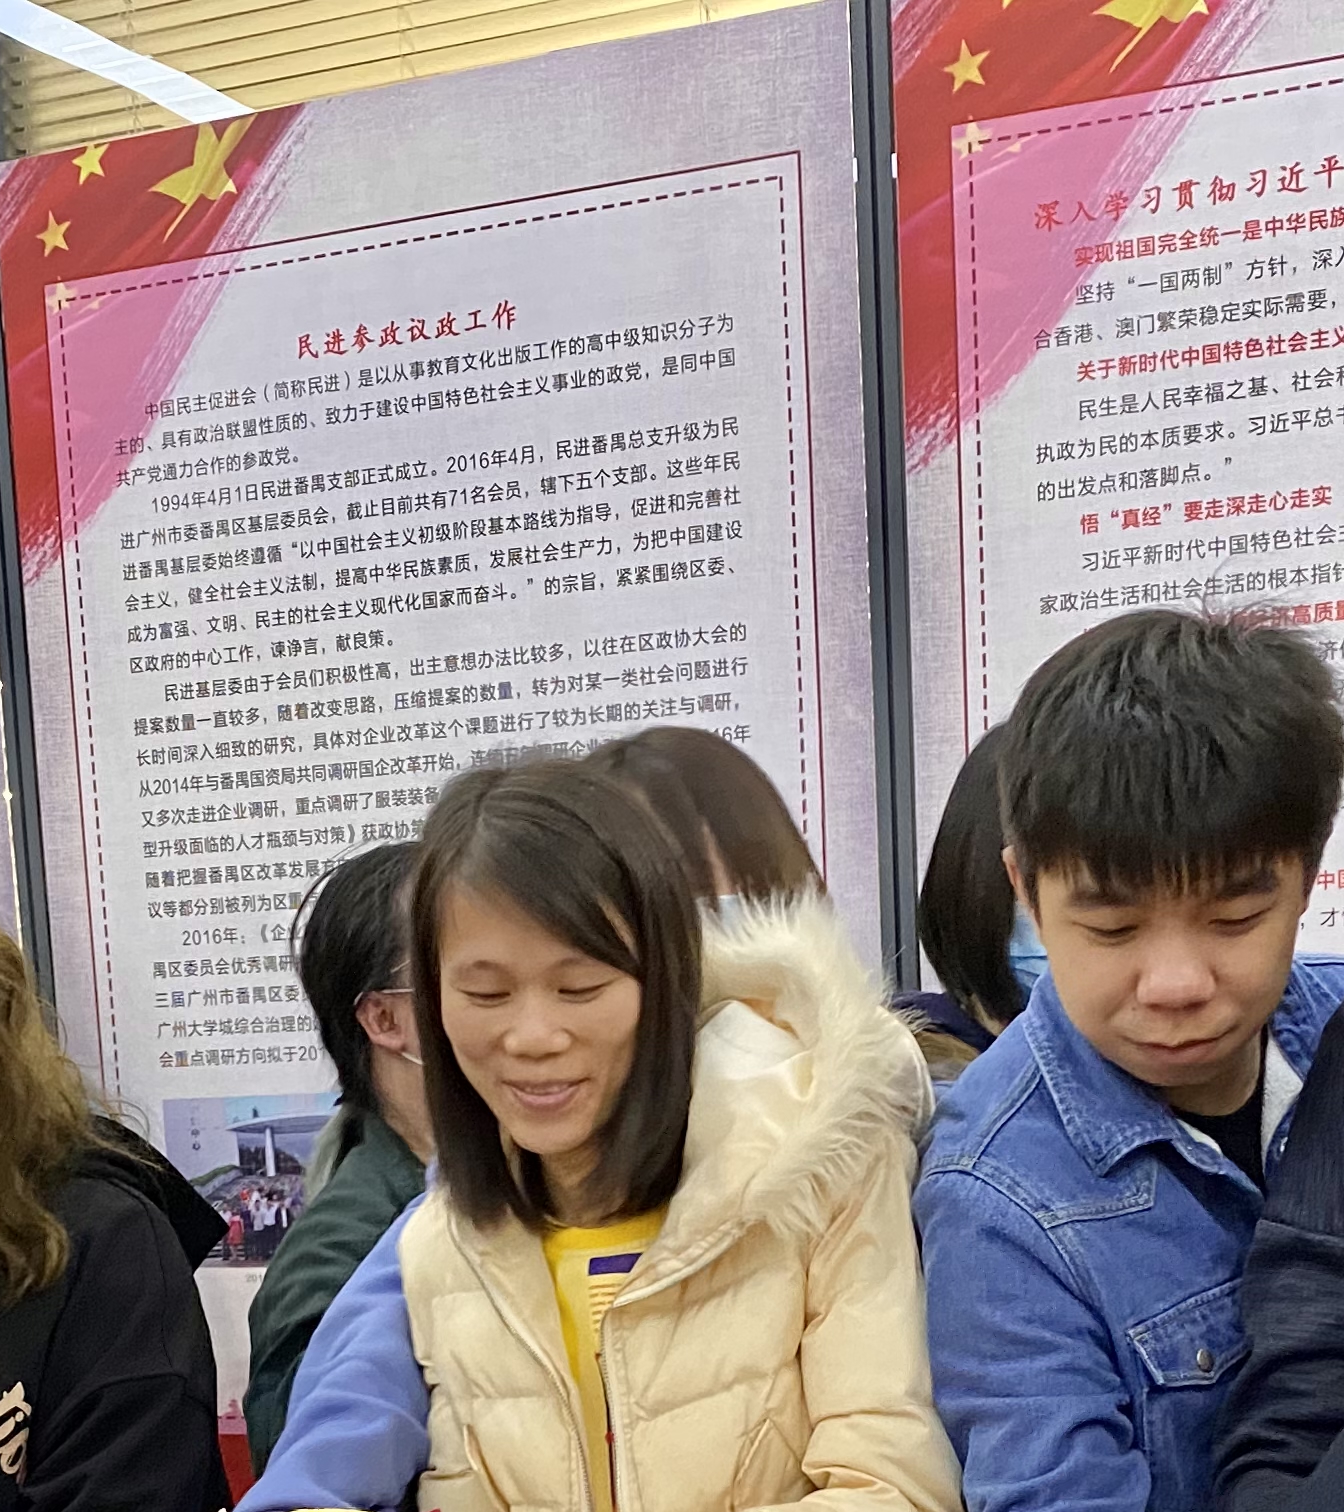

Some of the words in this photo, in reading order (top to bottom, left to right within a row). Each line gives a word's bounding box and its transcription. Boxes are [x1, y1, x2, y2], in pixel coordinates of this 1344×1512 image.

[143, 311, 734, 422] 中国民主促进会（简称民进）是以从事教育文化出版工作的高中级知识分子为
[295, 299, 518, 363] 民进参政议政工作
[113, 346, 736, 458] 主的、具有政治联盟性质的、致力于建设中国特色社会主义事业的政党，是同中国
[115, 443, 301, 489] 共产党通力合作的参政党。
[119, 450, 740, 551] 进广州市委番禺区基层委员会，截止目前共有71名会员，辖下五个支部。这些年民
[151, 415, 739, 515] 1994年4月1日民进番禺支部正式成立。2016年4月，民进番禺总支升级为民
[123, 520, 743, 613] 会主义，健全社会主义法制，提高中华民族素质，发展社会生产力，为把中国建设
[129, 627, 397, 675] 区政府的中心工作，谏诤言，献良策。
[163, 623, 748, 701] 民进基层委由于会员们积极性高，出主意想办法比较多，以往在区政协大会的
[136, 693, 740, 766] 长时间深入细致的研究，具体对企业改革这个课题进行了较为长期的关注与调研，
[154, 984, 306, 1008] 三届广州市番禺区委
